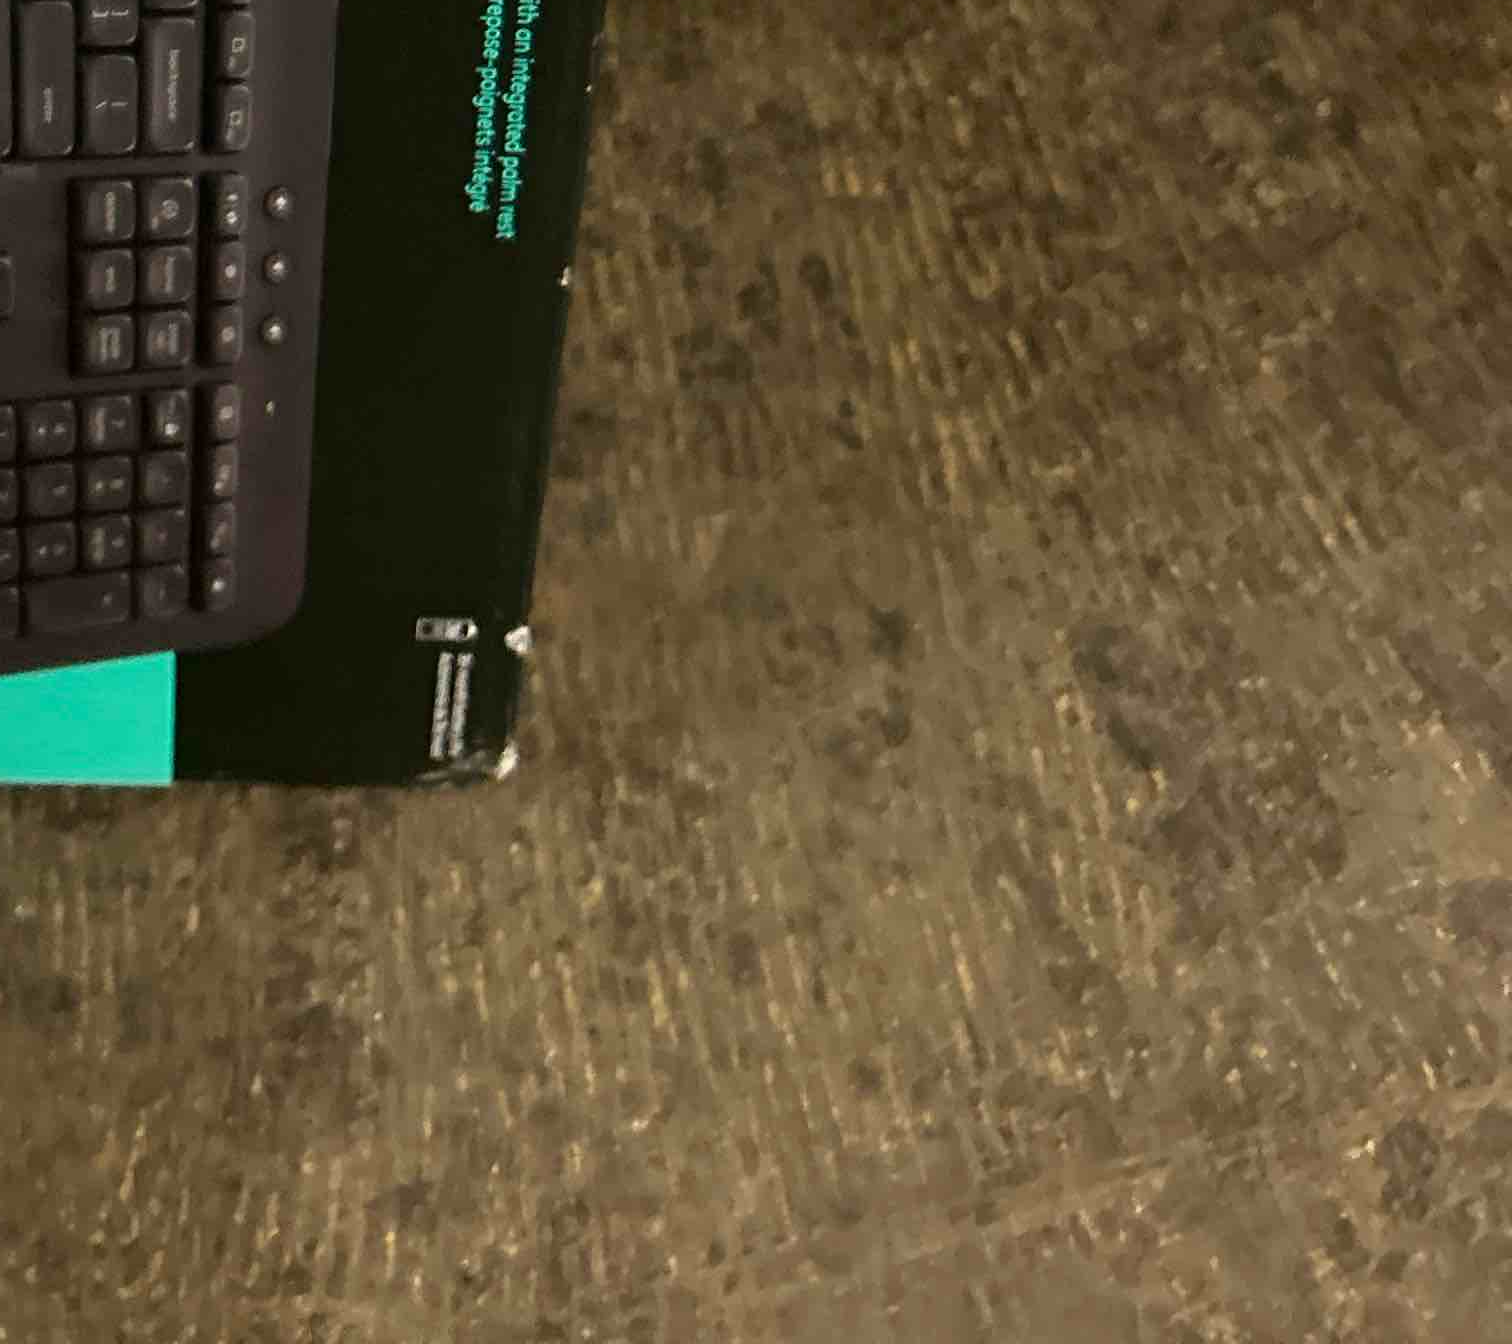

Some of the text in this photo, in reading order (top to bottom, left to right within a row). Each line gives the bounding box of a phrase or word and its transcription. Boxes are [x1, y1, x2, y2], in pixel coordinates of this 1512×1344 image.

[514, 27, 532, 54] an
[501, 57, 536, 153] integrated
[497, 155, 523, 203] palm
[495, 204, 517, 241] rest
